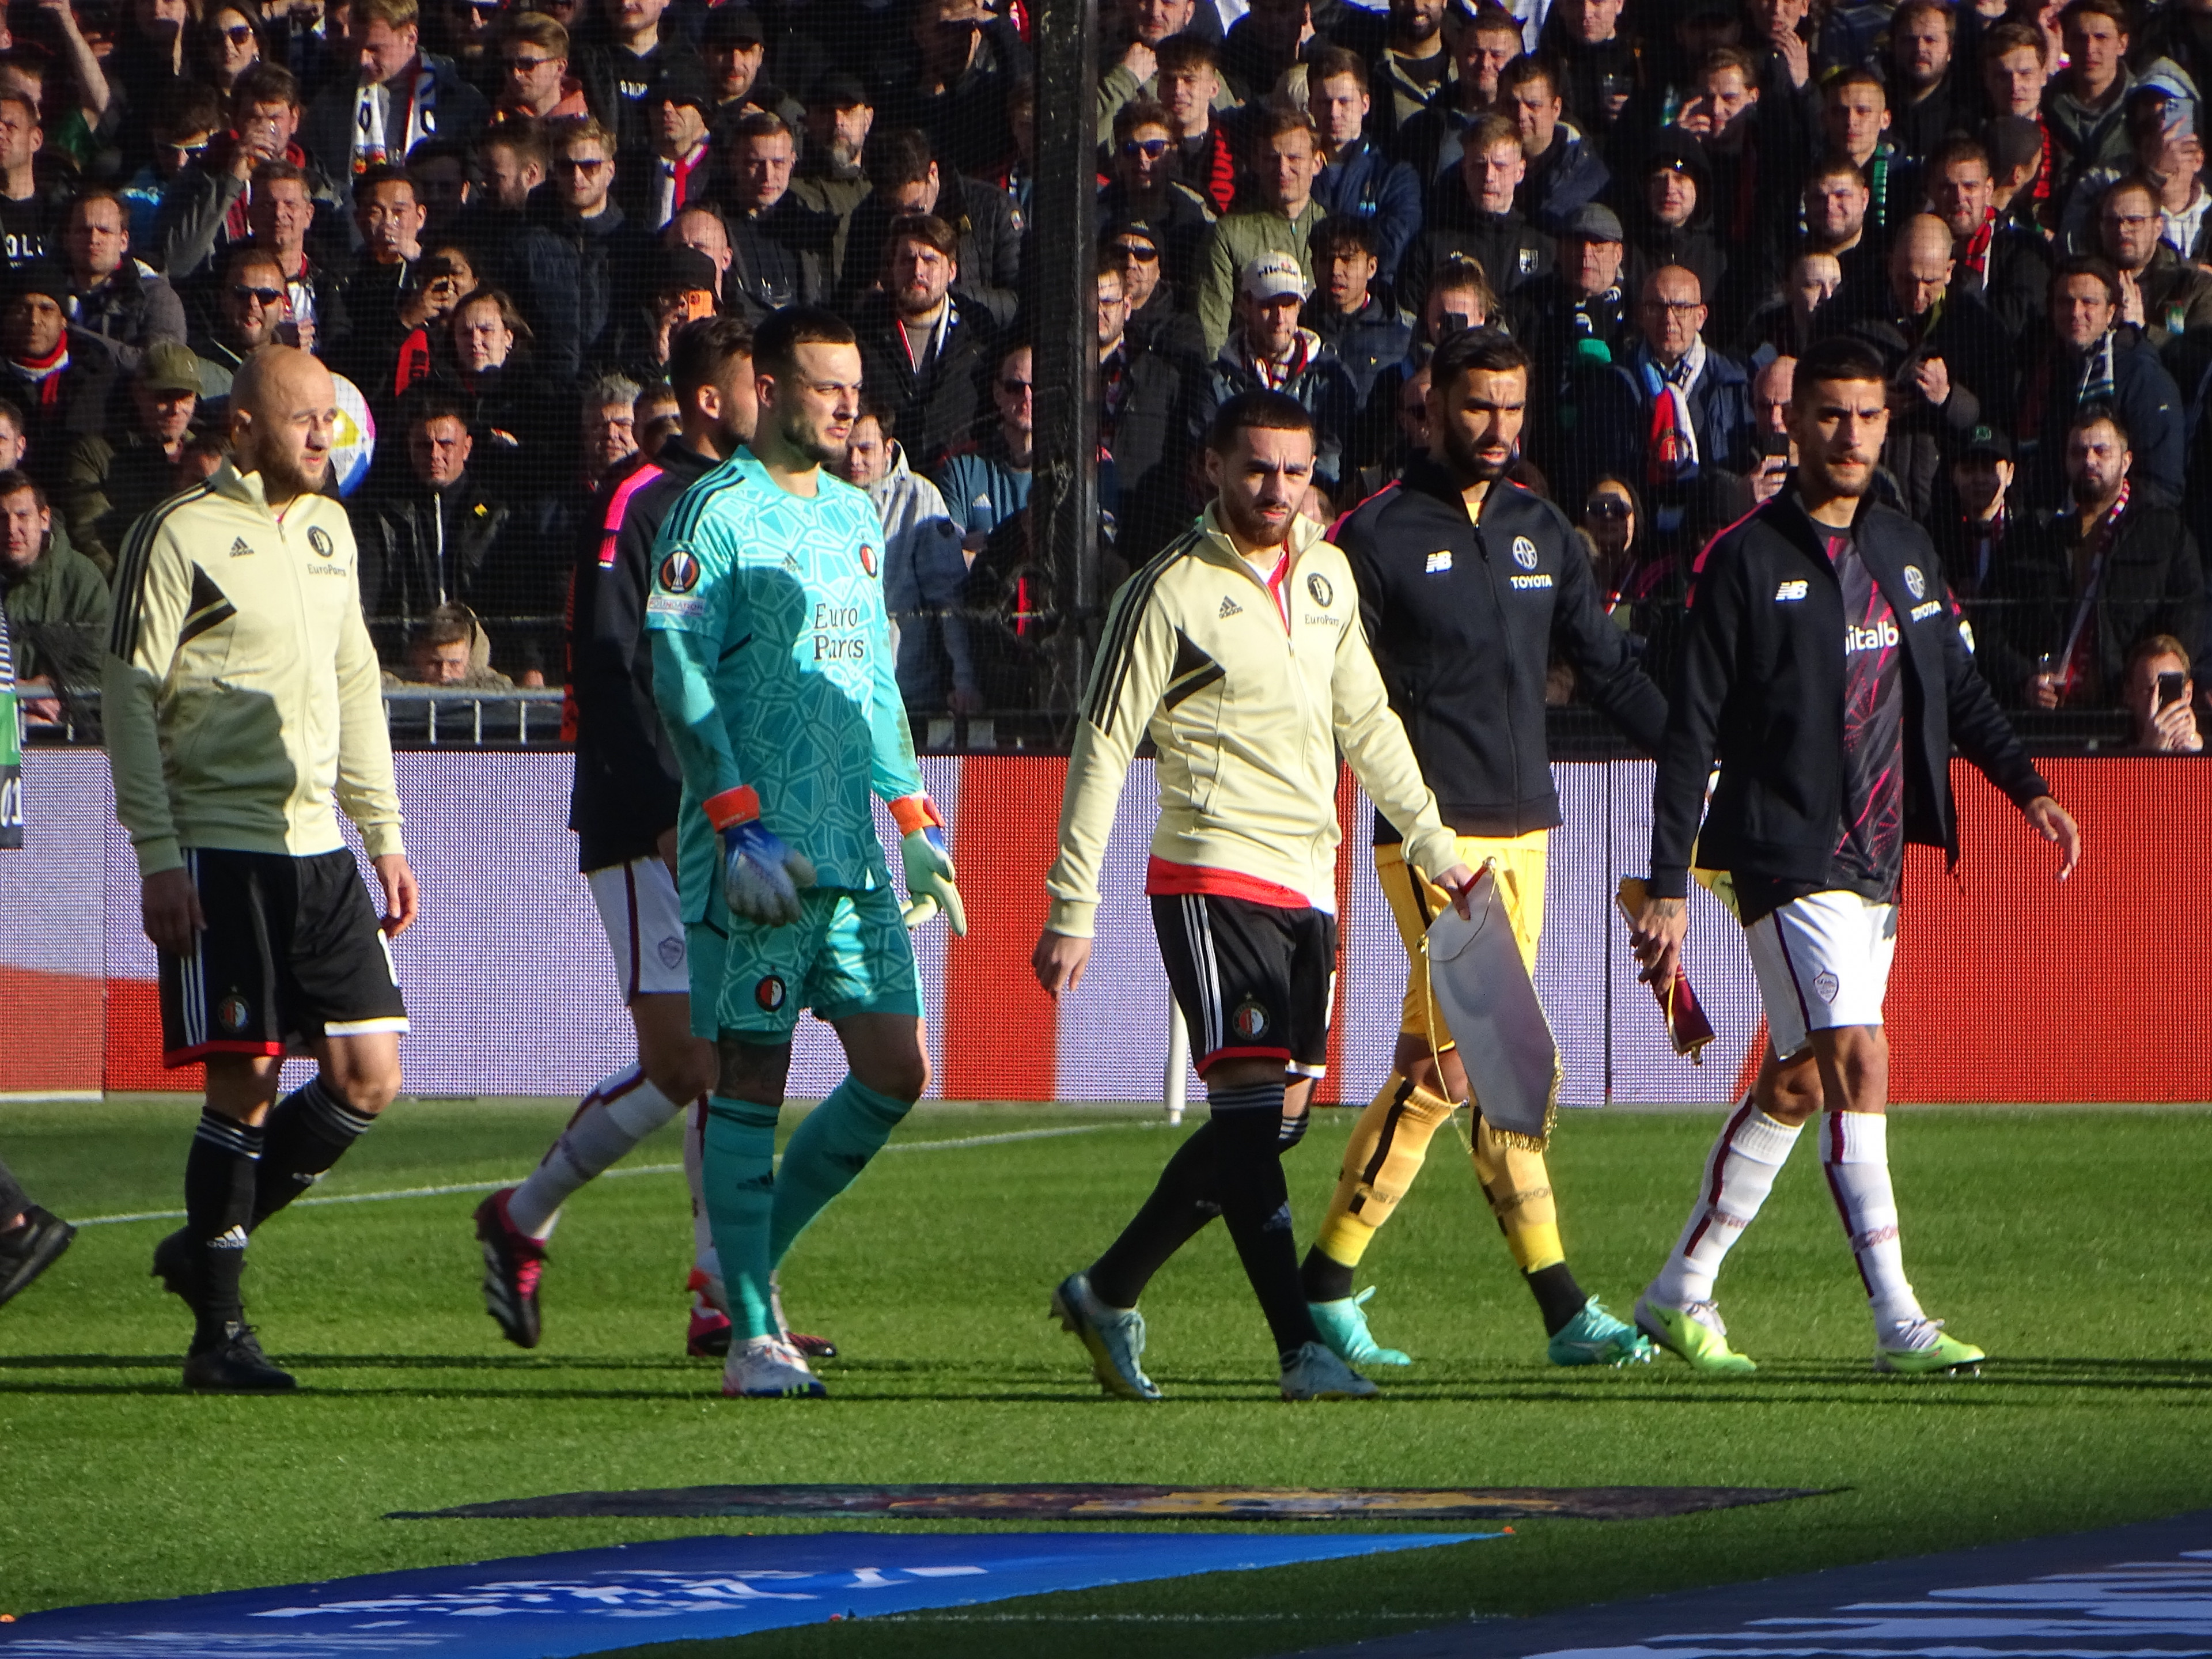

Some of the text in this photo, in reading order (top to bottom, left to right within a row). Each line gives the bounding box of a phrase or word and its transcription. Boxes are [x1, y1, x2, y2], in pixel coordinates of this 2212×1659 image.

[1510, 574, 1553, 589] TOYOTA
[813, 603, 857, 629] Euro
[813, 634, 863, 661] Parcs
